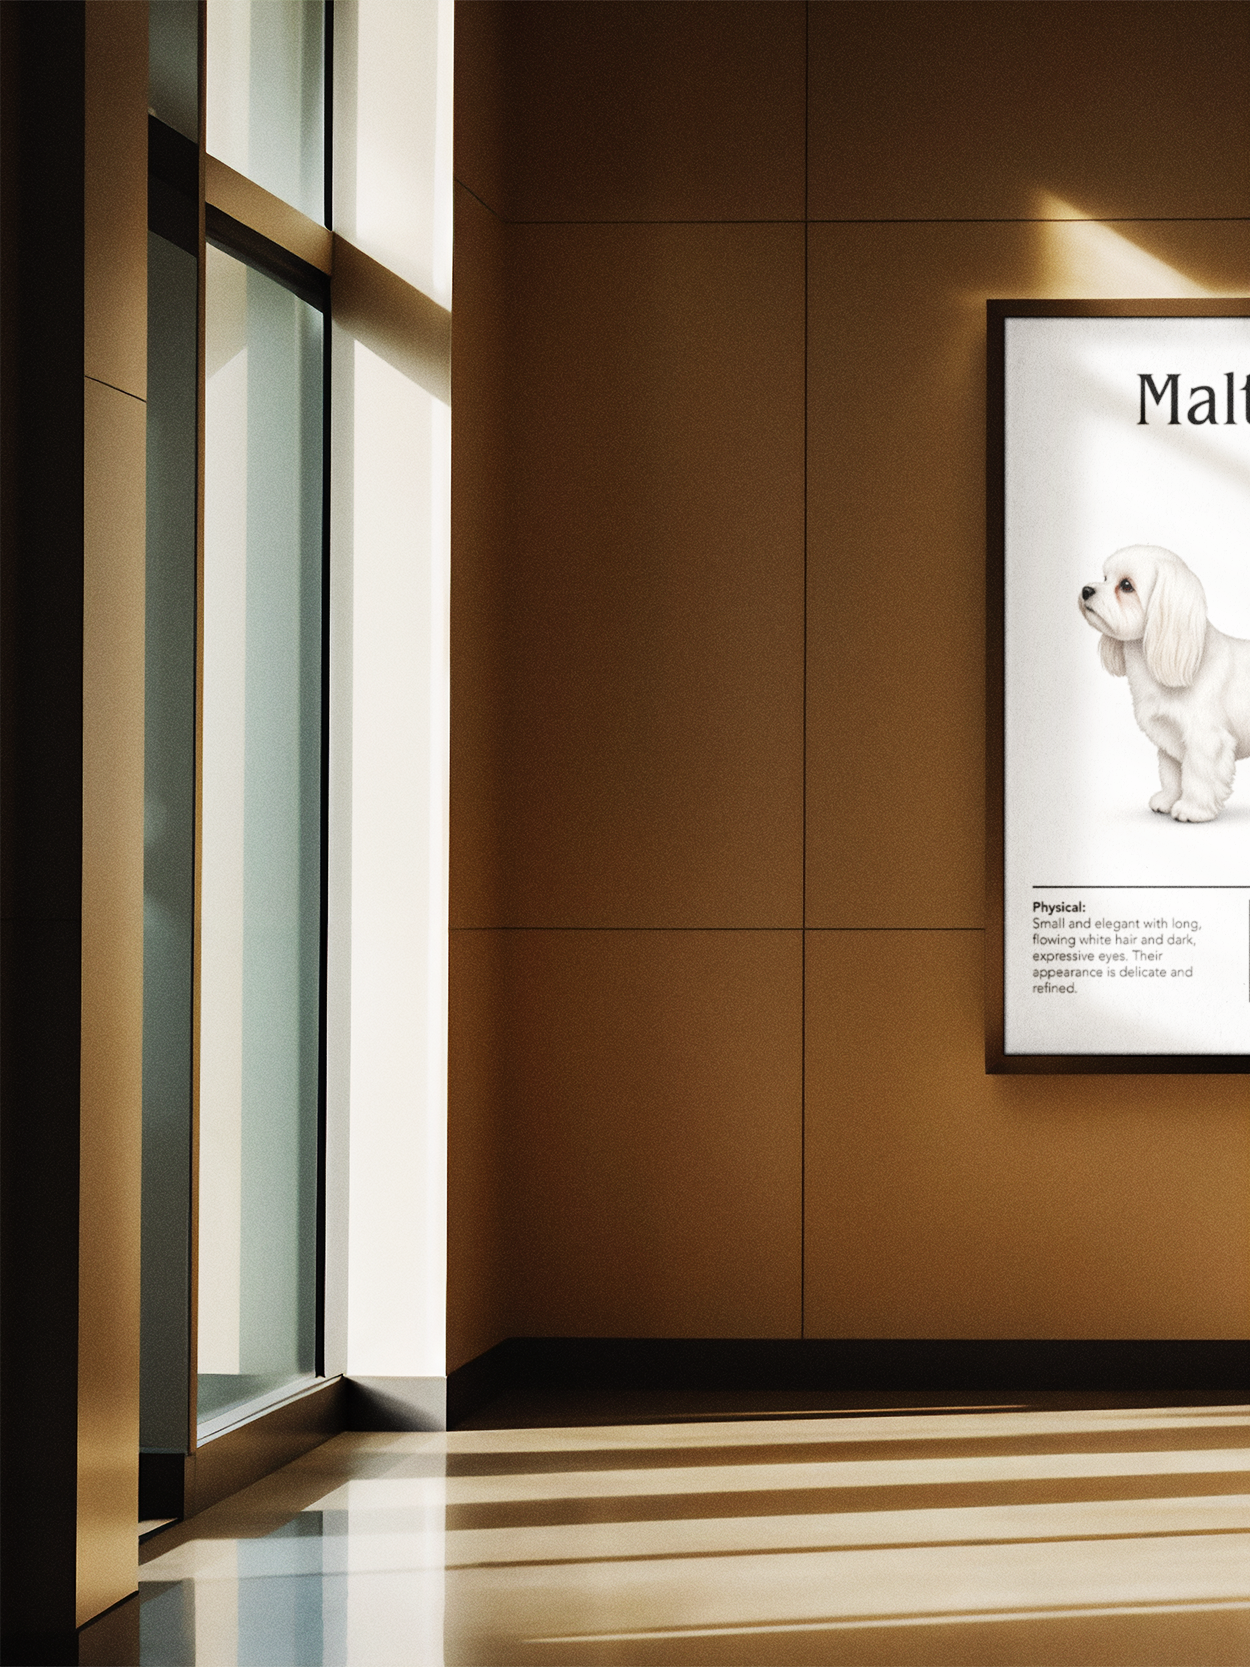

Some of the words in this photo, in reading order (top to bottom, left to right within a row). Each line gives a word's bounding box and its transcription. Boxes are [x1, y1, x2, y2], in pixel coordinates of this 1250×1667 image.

[1032, 901, 1087, 916] Physical:
[1032, 917, 1066, 930] Small
[1068, 918, 1092, 930] and
[1094, 918, 1140, 933] elegant
[1142, 918, 1168, 929] with
[1172, 919, 1202, 933] long,
[1032, 933, 1077, 949] flowing
[1078, 934, 1112, 946] white
[1115, 934, 1138, 946] hair
[1140, 934, 1164, 946] and
[1166, 934, 1196, 947] dark,
[1032, 951, 1095, 964] expressive
[1098, 953, 1128, 965] eyes.
[1131, 950, 1163, 962] Their
[1032, 969, 1104, 981] appearance
[1107, 967, 1116, 978] is
[1119, 966, 1167, 978] delicate
[1170, 966, 1193, 978] and
[1032, 982, 1078, 994] refined.
